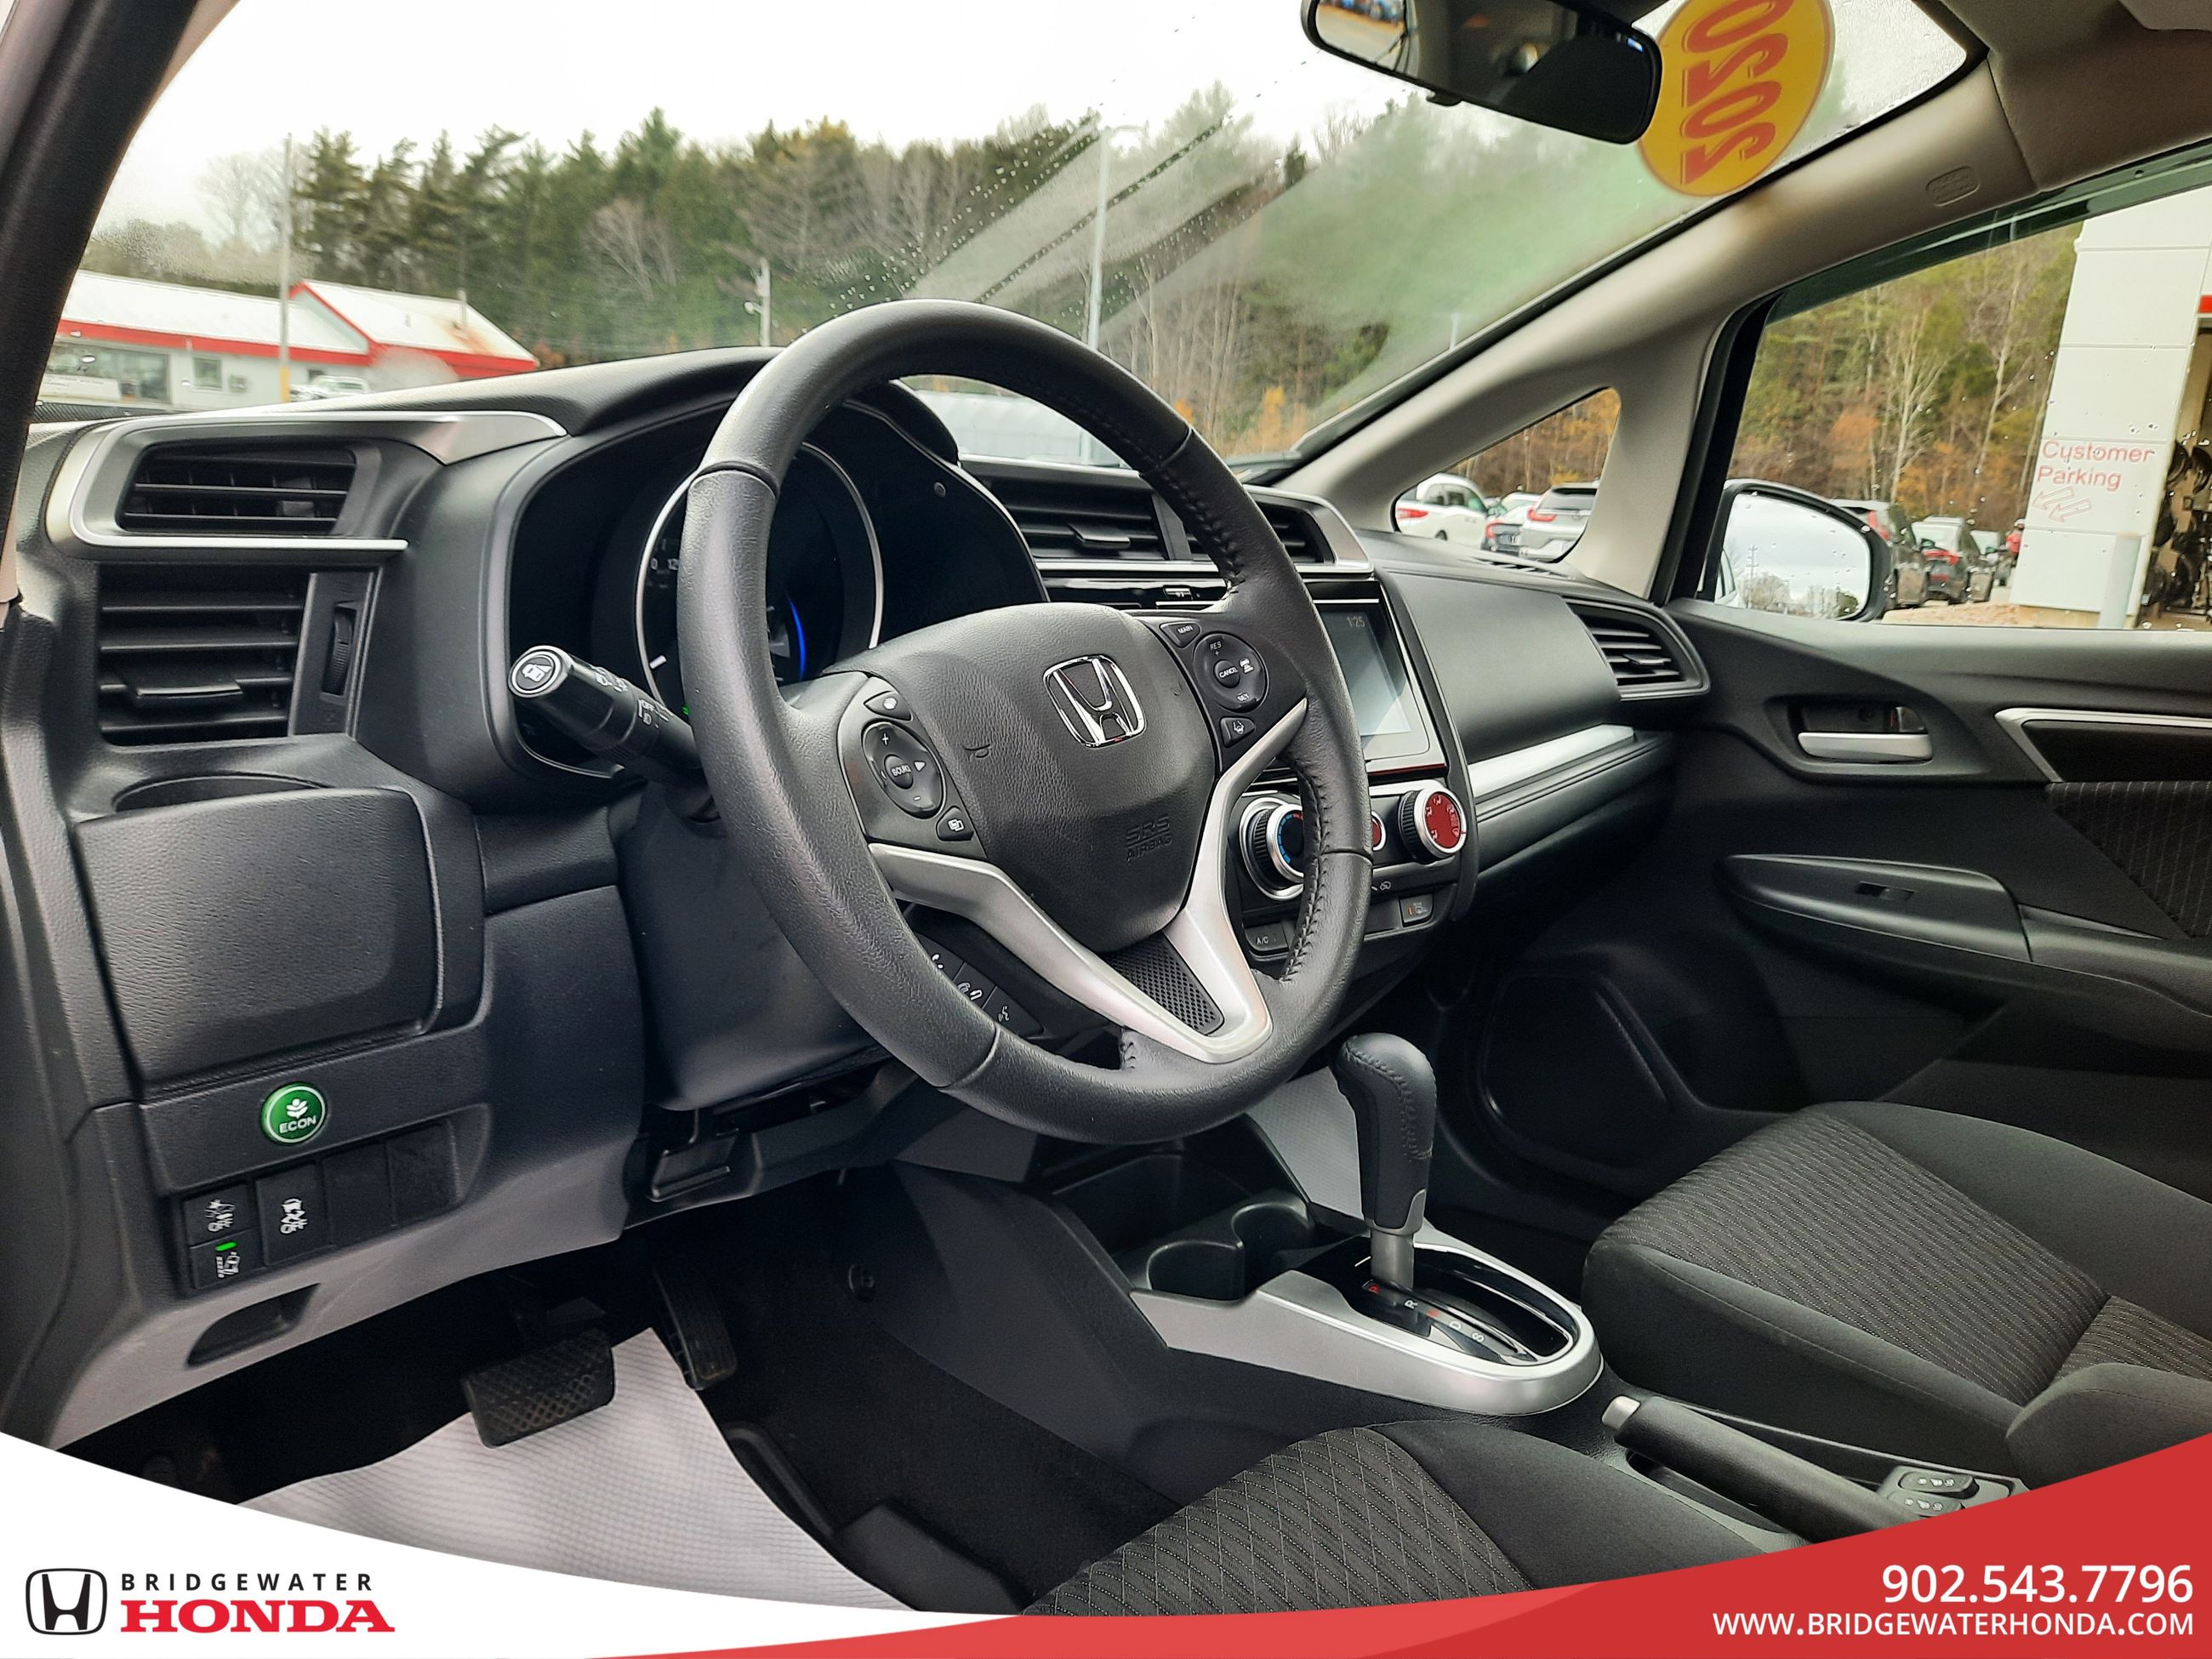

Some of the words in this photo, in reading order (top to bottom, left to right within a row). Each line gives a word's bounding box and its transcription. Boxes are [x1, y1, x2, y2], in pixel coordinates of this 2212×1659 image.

[2042, 439, 2155, 463] Customer
[2037, 465, 2123, 492] Parking
[1210, 641, 1222, 651] RES
[1126, 814, 1170, 844] SRS
[1257, 936, 1269, 944] A/C
[279, 1115, 316, 1134] ECON
[1405, 1299, 1418, 1309] R
